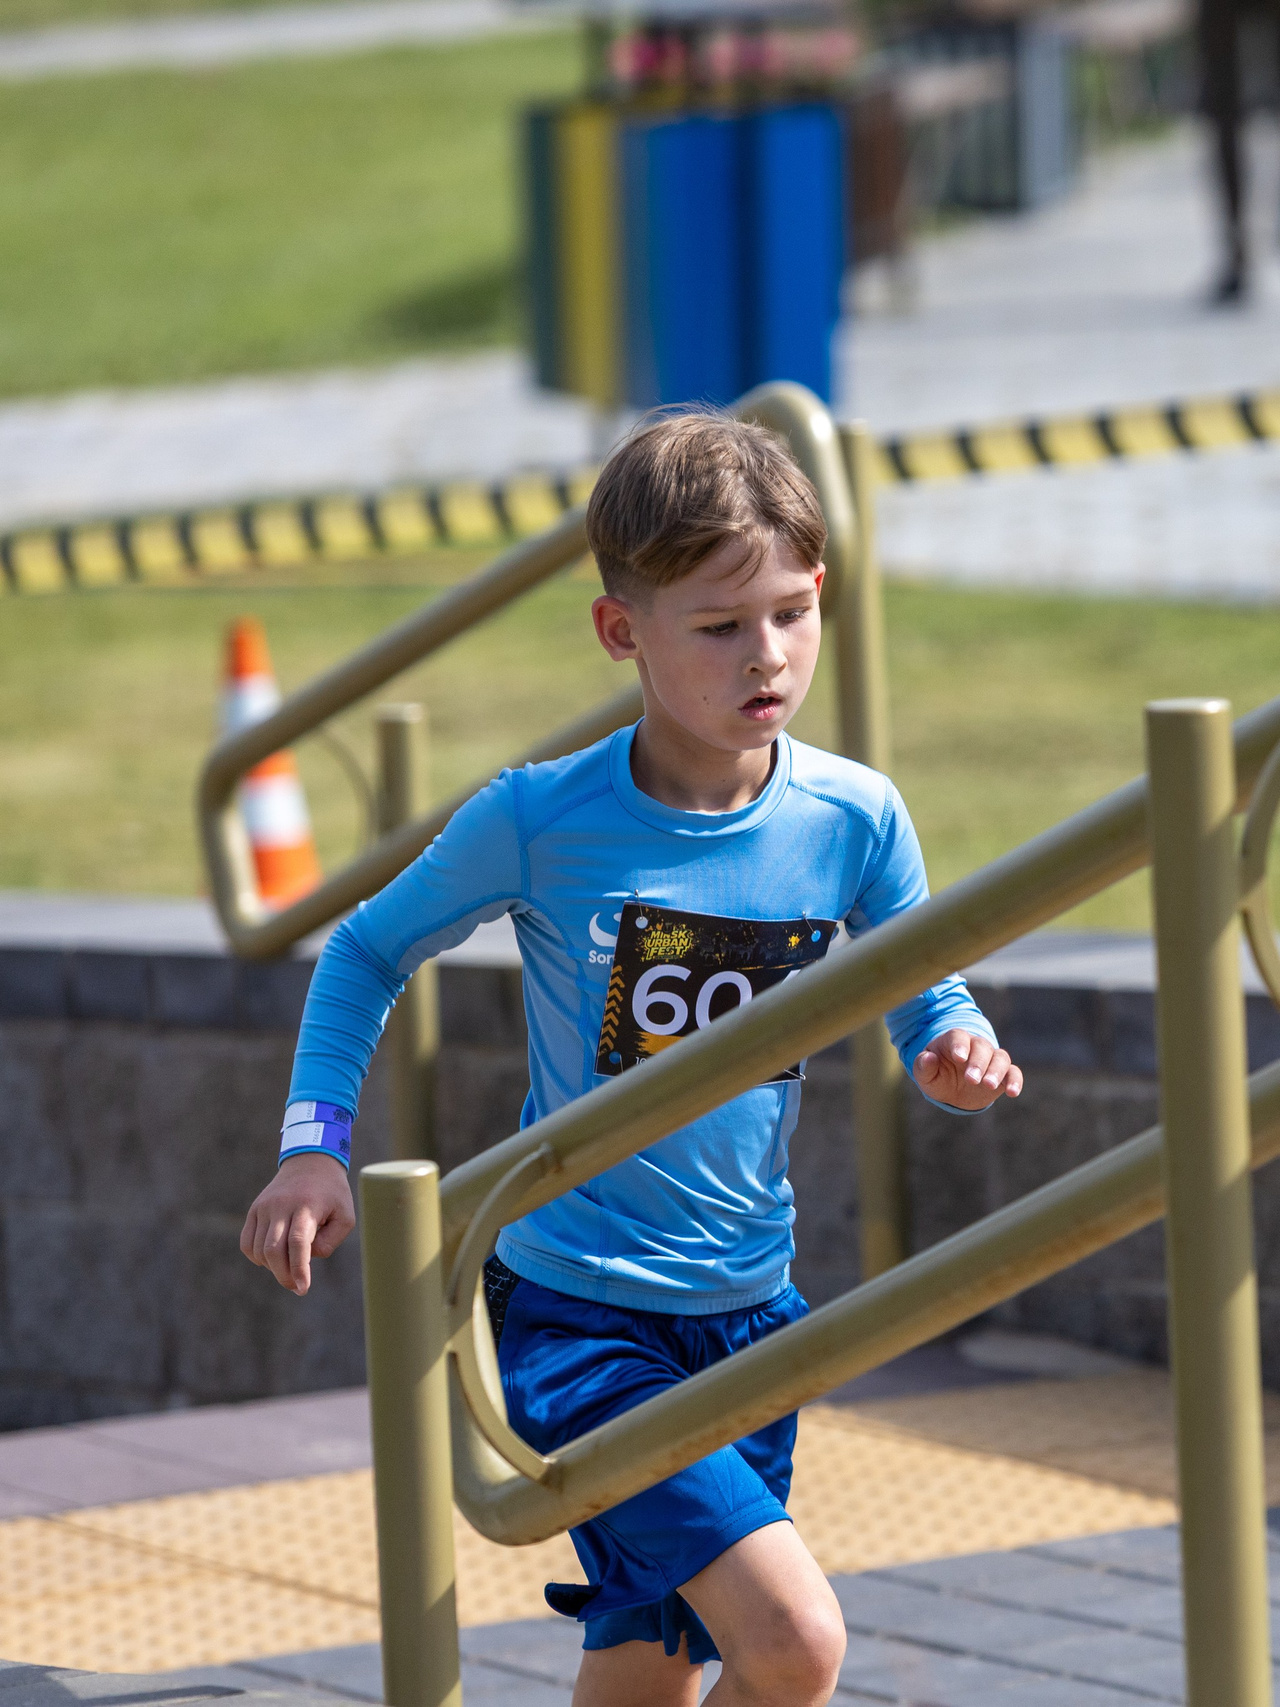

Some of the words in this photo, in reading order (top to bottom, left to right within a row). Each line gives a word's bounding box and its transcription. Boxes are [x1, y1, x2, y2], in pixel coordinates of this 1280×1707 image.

[650, 930, 688, 939] MINSK
[646, 938, 689, 947] URBAN
[650, 946, 684, 957] FEST
